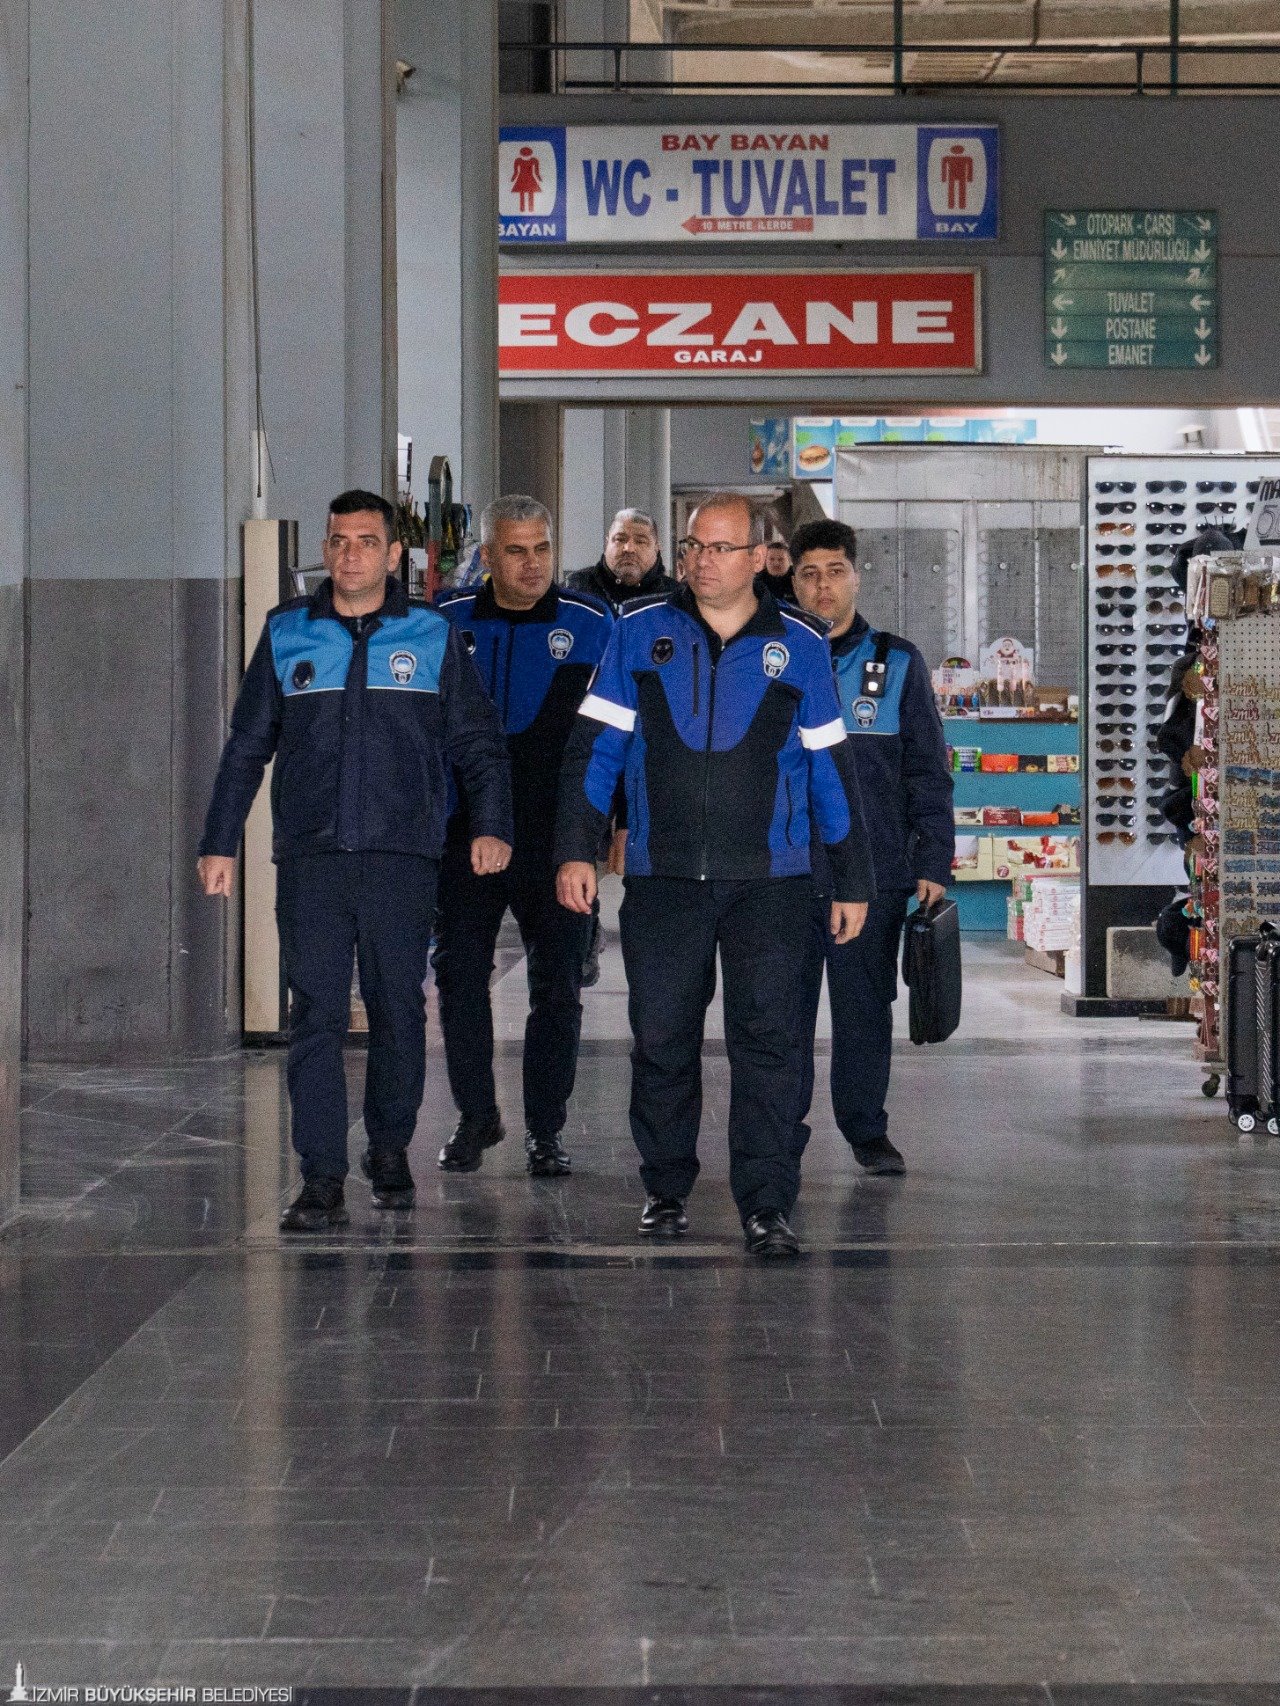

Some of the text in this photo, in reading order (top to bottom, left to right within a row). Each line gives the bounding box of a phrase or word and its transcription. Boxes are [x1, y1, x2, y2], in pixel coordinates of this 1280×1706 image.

[661, 134, 829, 151] BAY BAYAN
[582, 158, 651, 217] WC
[692, 158, 897, 216] TUVALET
[701, 220, 713, 231] 10
[717, 220, 752, 231] METRE
[935, 222, 978, 234] BAY
[1087, 213, 1134, 235] OTOPARK
[1107, 292, 1155, 313] TUVALET
[499, 300, 955, 346] ECZANE
[1106, 318, 1156, 339] POSTANE
[674, 350, 763, 364] GARAJ
[1108, 344, 1154, 365] EMANET
